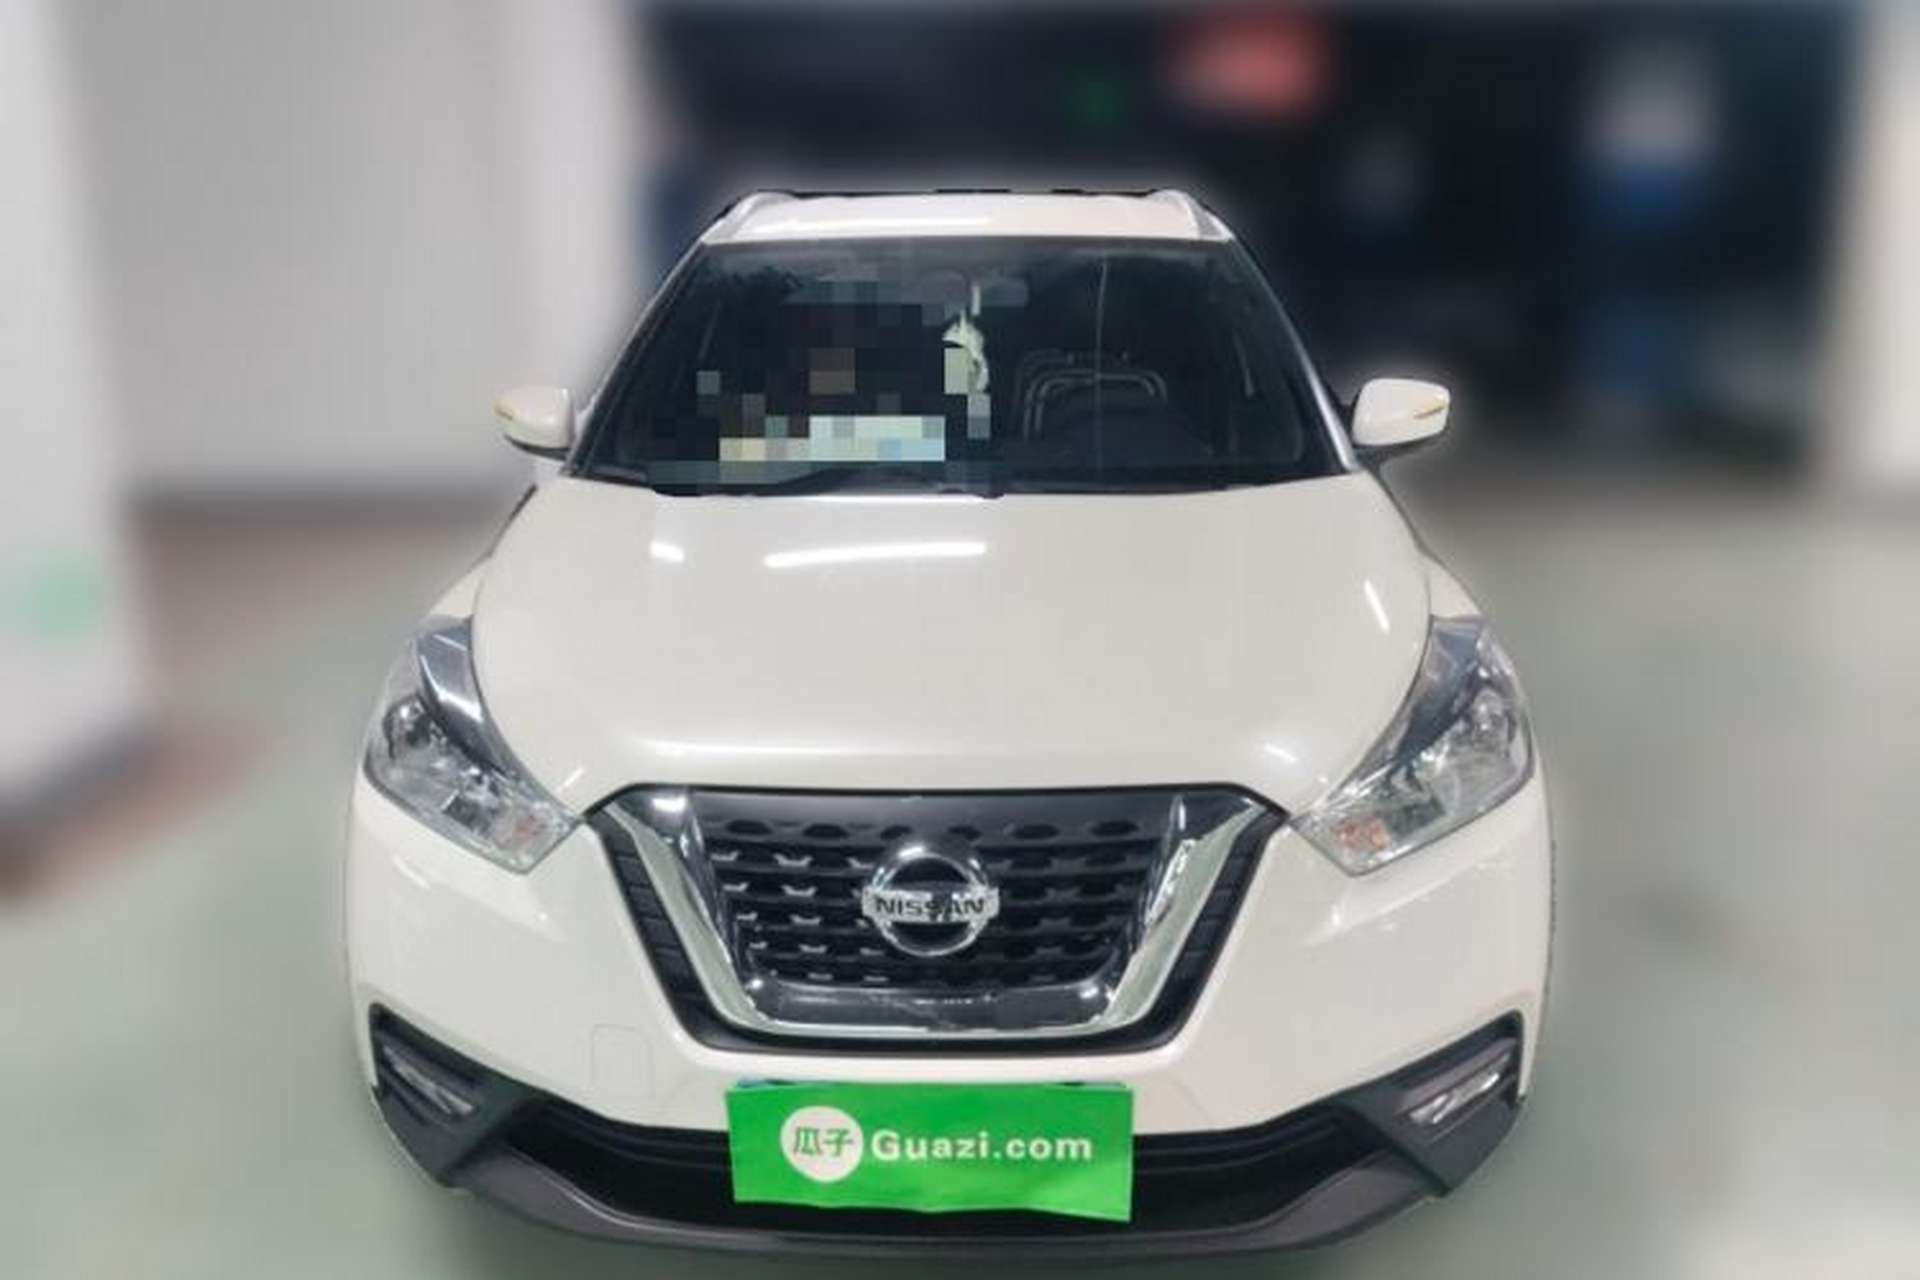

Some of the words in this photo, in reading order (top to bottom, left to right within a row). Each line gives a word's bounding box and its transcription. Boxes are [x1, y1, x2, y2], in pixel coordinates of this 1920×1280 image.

[874, 897, 985, 917] NISSAN
[792, 1126, 854, 1156] 瓜子
[870, 1129, 1093, 1161] Guazi.com
